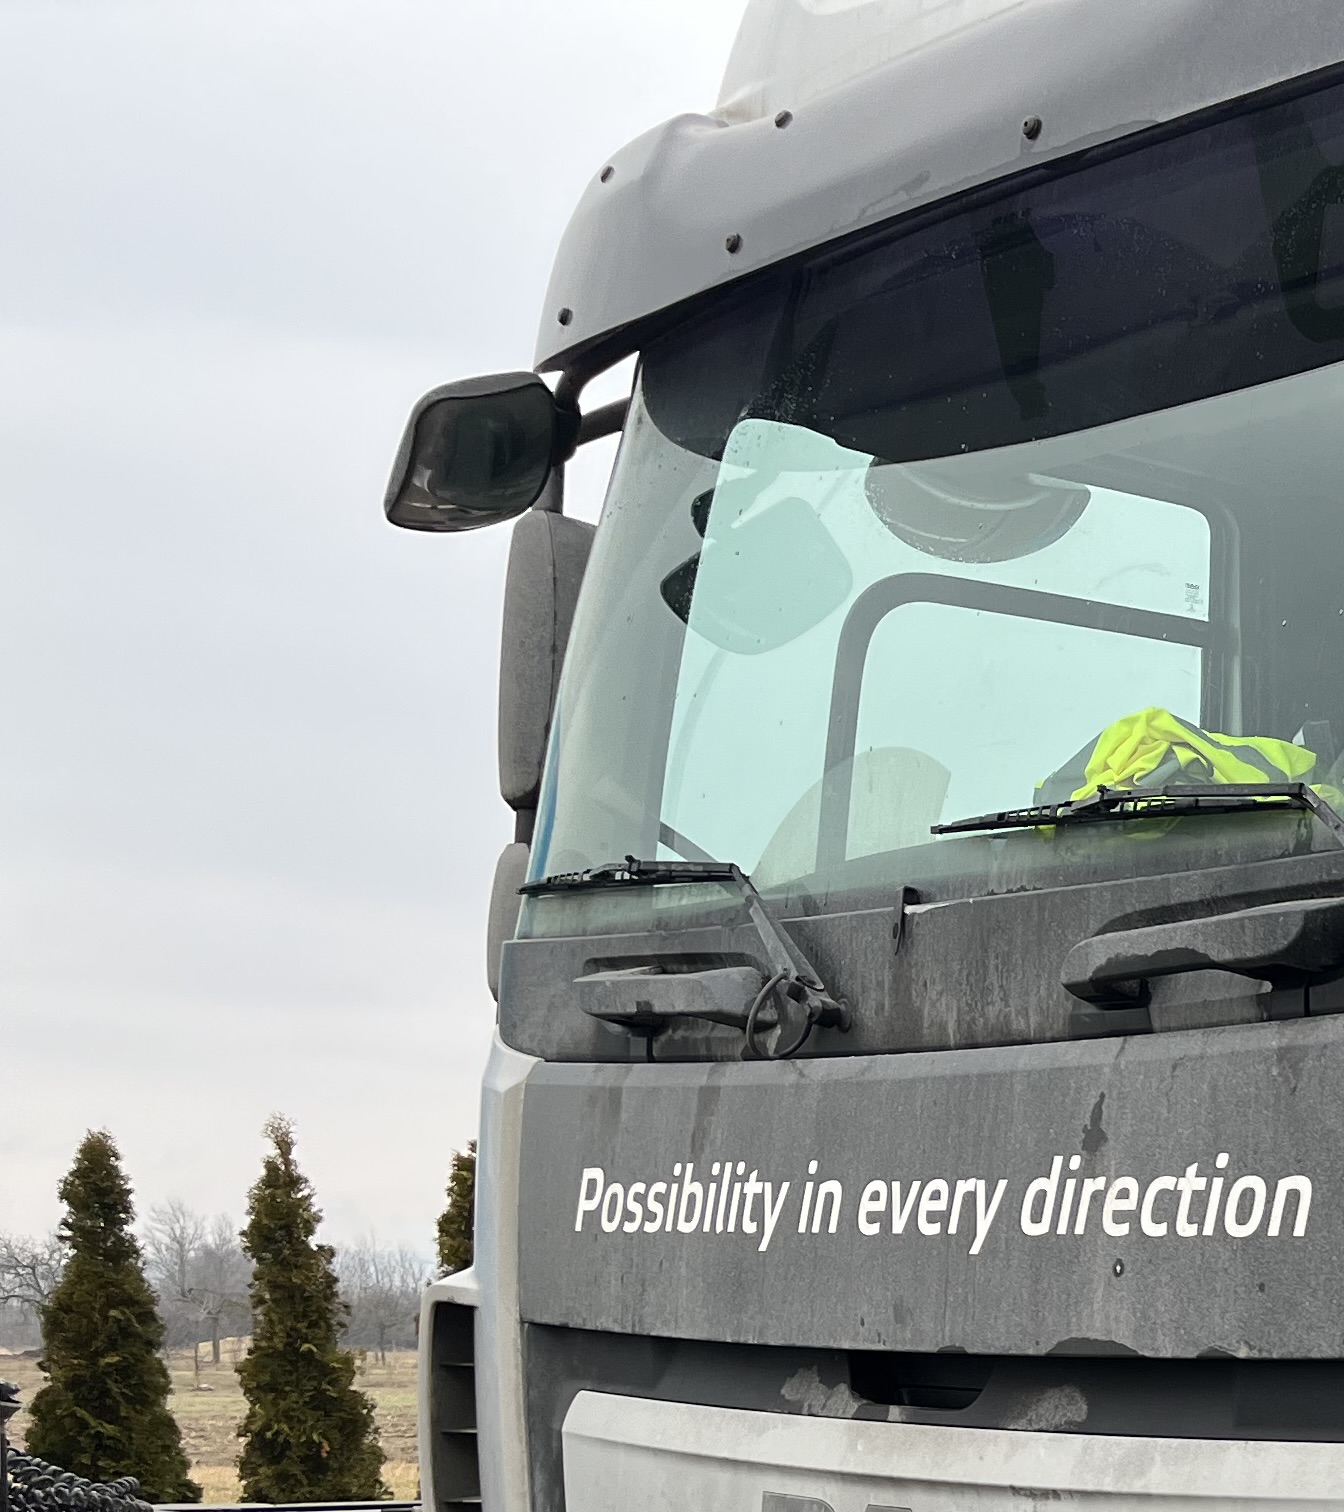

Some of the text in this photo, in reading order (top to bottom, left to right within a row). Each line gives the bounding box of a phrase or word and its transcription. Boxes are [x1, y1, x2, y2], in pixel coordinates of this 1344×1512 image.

[574, 1152, 1313, 1255] Possibility in every direction
